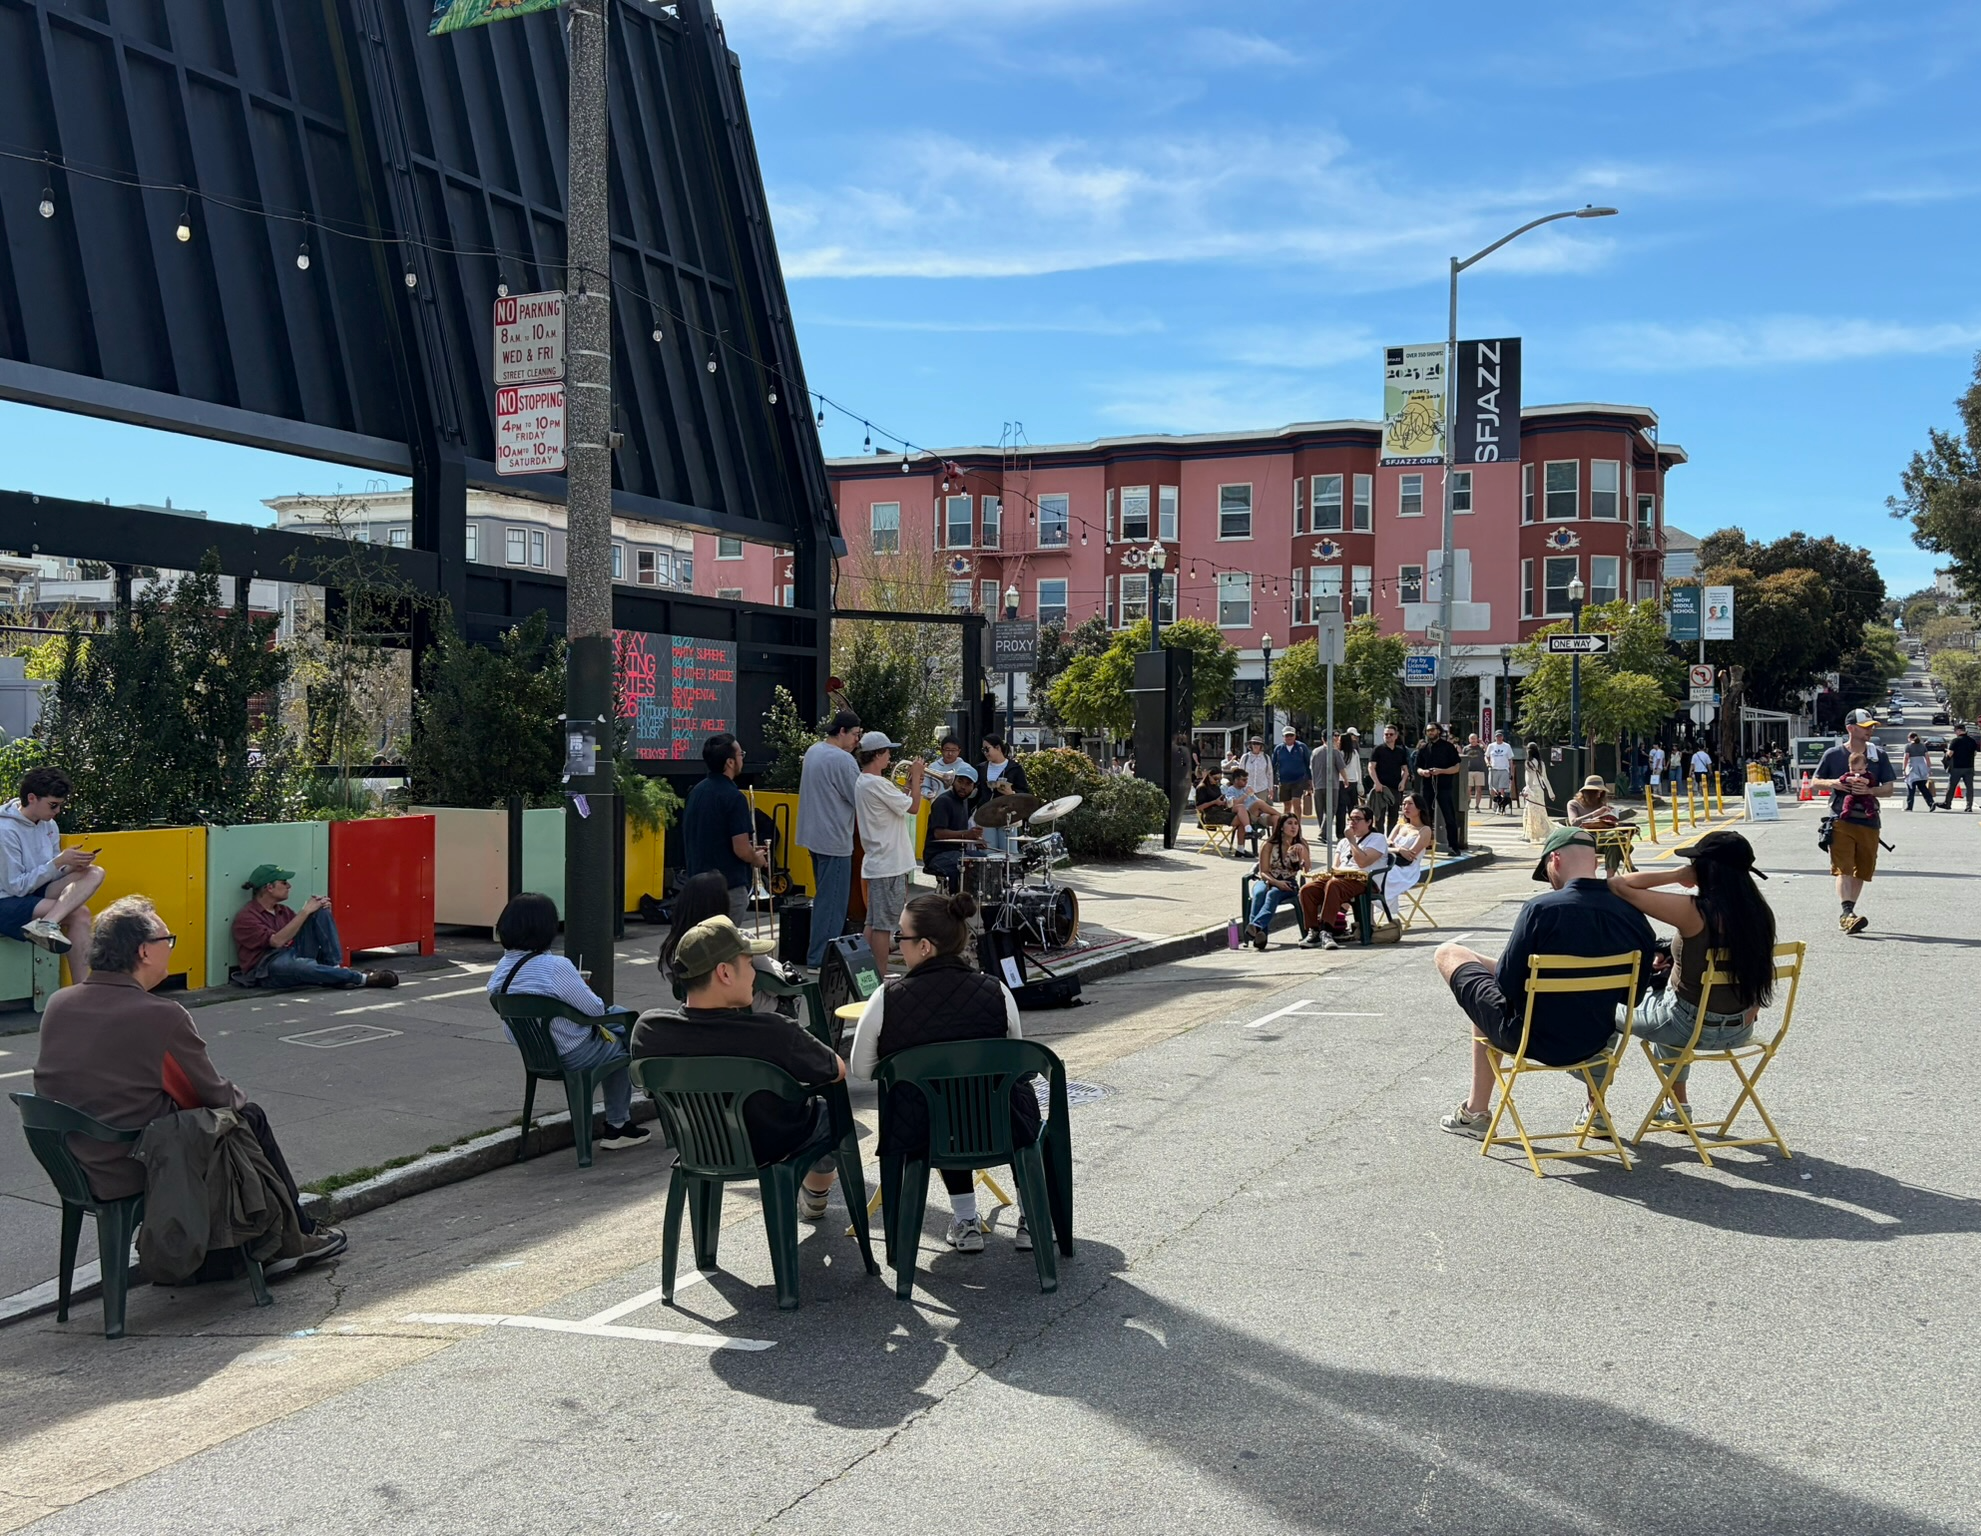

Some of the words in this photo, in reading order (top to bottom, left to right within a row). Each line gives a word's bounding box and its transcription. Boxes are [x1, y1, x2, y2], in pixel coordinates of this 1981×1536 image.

[497, 300, 516, 323] NO
[519, 299, 560, 319] PARKING
[502, 350, 523, 364] WED
[526, 347, 533, 361] &
[537, 346, 554, 360] FRI
[502, 369, 525, 380] STREET
[527, 366, 557, 378] CLEANING
[499, 391, 516, 413] NO
[518, 391, 563, 412] STOPPING
[1474, 341, 1501, 463] SFJAZZ
[515, 430, 546, 441] FRIDAY
[509, 456, 553, 468] SATURDAY
[1385, 458, 1439, 466] SFJAZZ.ORG
[611, 629, 648, 654] ROXY
[995, 639, 1035, 652] PROXY
[1552, 639, 1571, 649] ONE
[1572, 638, 1592, 648] WAY
[672, 646, 695, 658] MARTY
[696, 648, 727, 663] SUPREME
[1407, 657, 1418, 665] Pay
[1419, 657, 1427, 665] by
[672, 667, 682, 678] NO
[685, 668, 706, 681] OTHER
[709, 669, 734, 682] CHOICE
[672, 687, 717, 701] SENTIMENTAL
[672, 697, 694, 710] VALUE
[637, 706, 669, 718] OUTDOOR
[637, 716, 664, 729] MOVIES
[672, 718, 699, 731] LITTLE
[701, 719, 726, 732] AMELIE
[671, 728, 694, 740] 04/24
